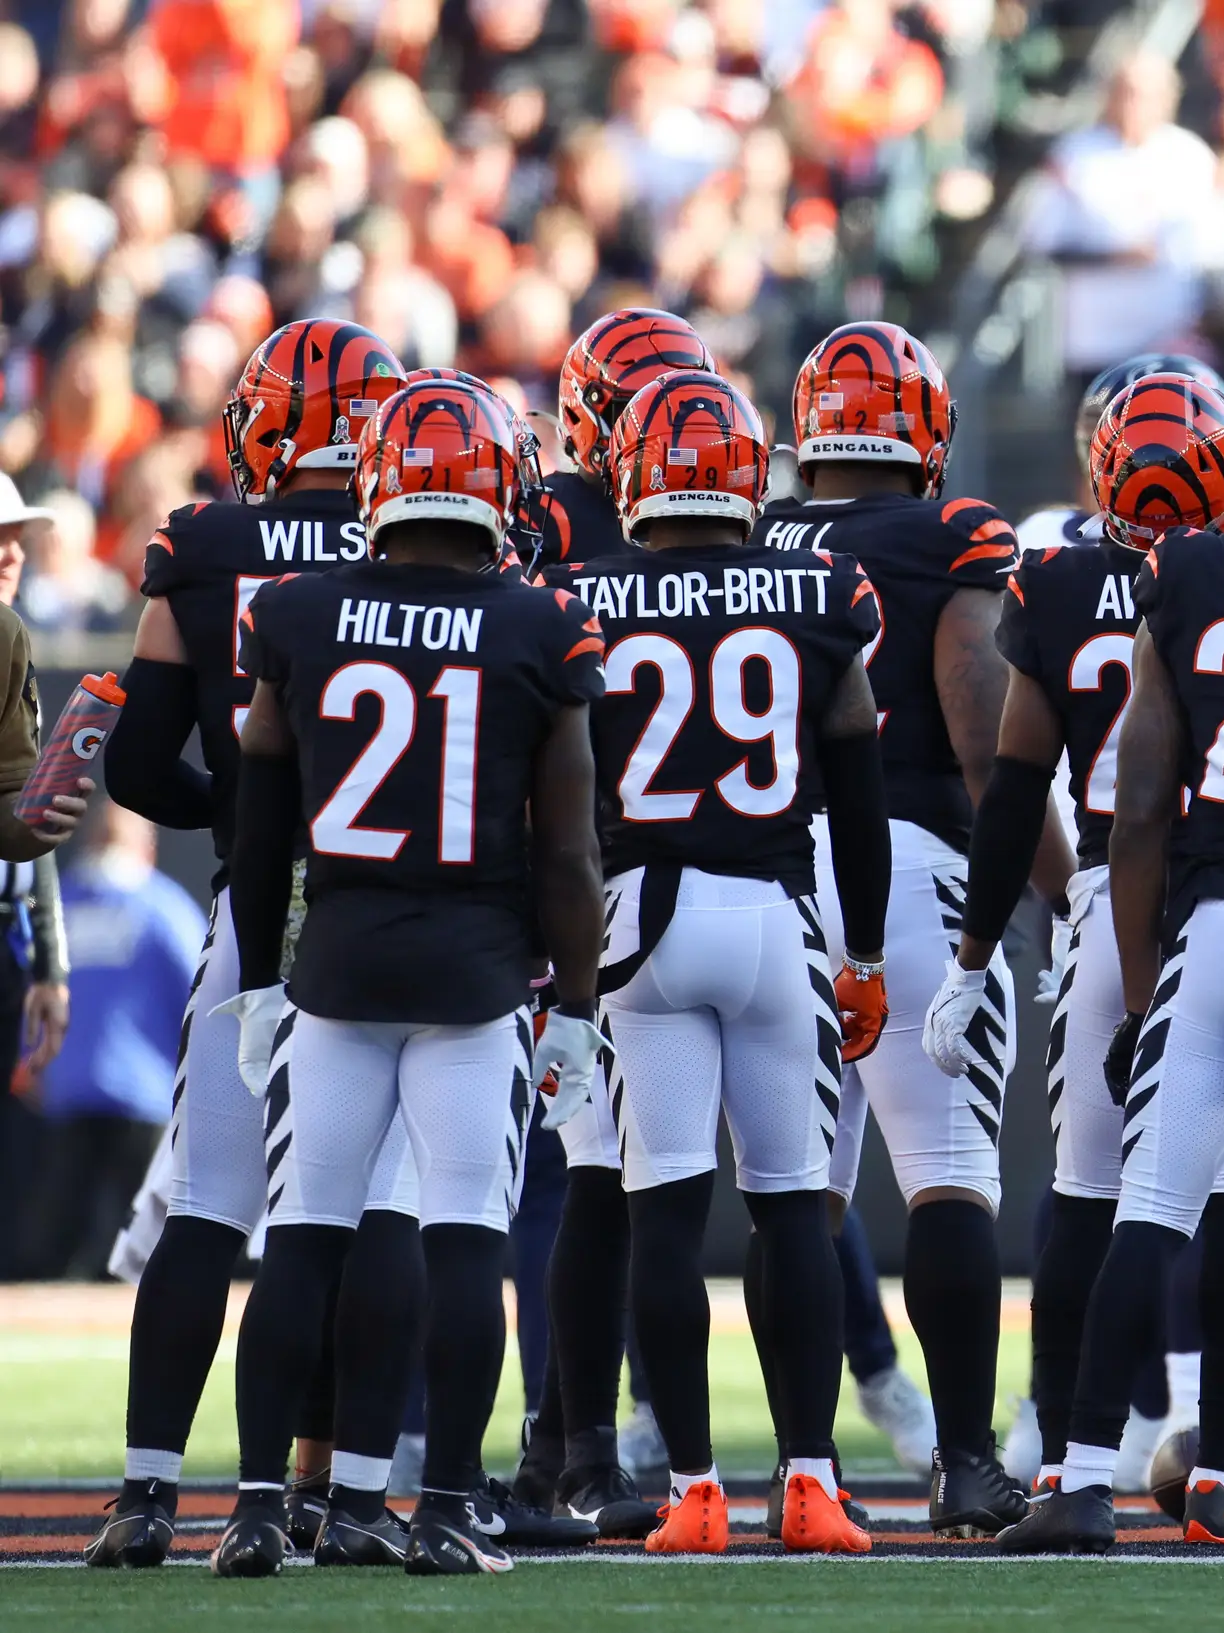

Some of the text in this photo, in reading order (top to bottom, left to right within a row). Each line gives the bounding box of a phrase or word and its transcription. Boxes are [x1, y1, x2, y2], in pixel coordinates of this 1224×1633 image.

[812, 443, 893, 453] BENGALS
[404, 495, 469, 505] BENGALS
[668, 493, 730, 503] BENGALS
[258, 520, 387, 561] WILS
[765, 521, 833, 552] HILL
[573, 567, 832, 620] TAYLOR-BRITT
[336, 598, 483, 653] HILTON
[604, 626, 801, 823] 29
[310, 660, 483, 865] 21
[938, 1472, 947, 1504] MENACE
